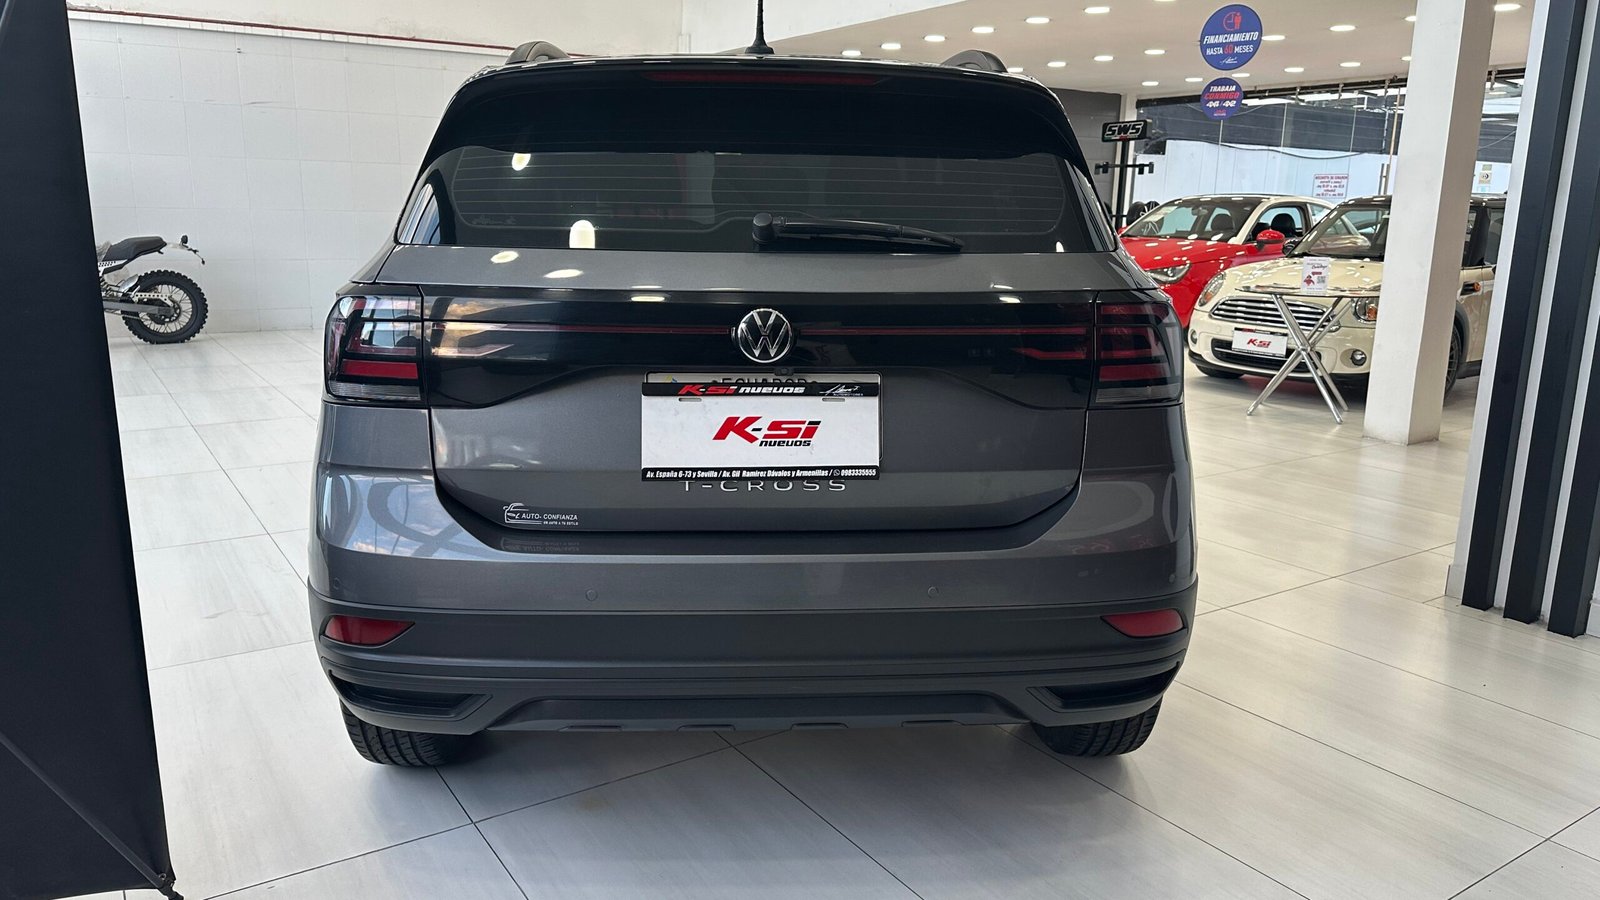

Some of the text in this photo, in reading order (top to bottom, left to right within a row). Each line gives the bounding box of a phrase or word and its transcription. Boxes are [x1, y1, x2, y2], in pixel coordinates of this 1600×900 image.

[1203, 31, 1259, 44] FINANCIAMIENTO
[1206, 44, 1254, 55] HASTA 60 MESES
[1204, 91, 1240, 100] CONMIGO
[1104, 121, 1144, 137] SWS
[656, 470, 678, 480] España
[678, 470, 692, 478] 6-73
[697, 470, 718, 478] Sevilla
[722, 470, 731, 478] Av.
[543, 513, 578, 521] CONFIANZA
